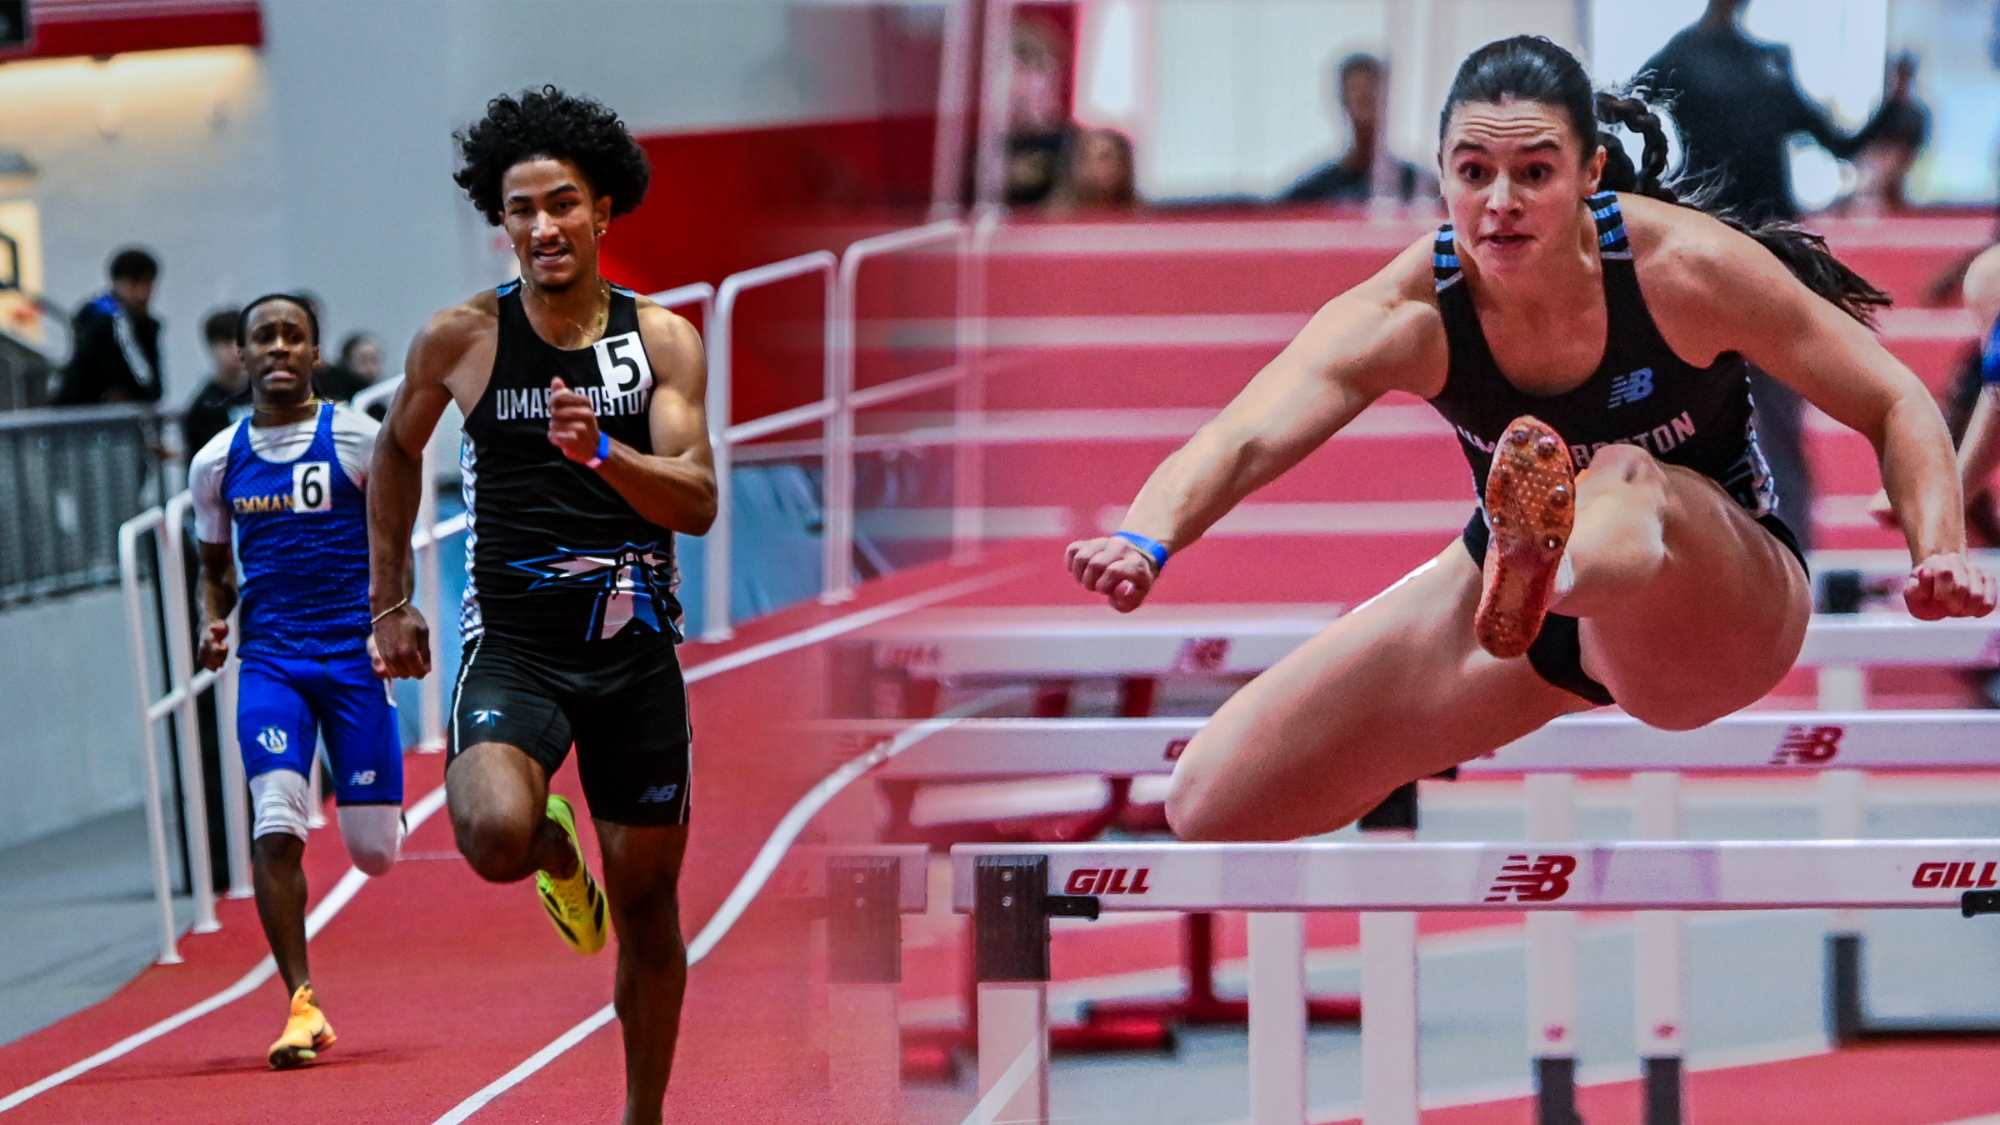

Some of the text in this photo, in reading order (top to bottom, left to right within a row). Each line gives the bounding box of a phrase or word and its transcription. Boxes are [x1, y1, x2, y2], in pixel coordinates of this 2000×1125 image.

[606, 338, 641, 393] 5
[496, 387, 552, 420] UMAS
[1607, 367, 1654, 409] NB
[1569, 410, 1696, 468] BTON
[301, 466, 322, 509] 6
[1769, 726, 1843, 765] NB
[1064, 868, 1150, 895] GILL
[1484, 855, 1577, 902] NB
[1911, 862, 1998, 888] GILL
